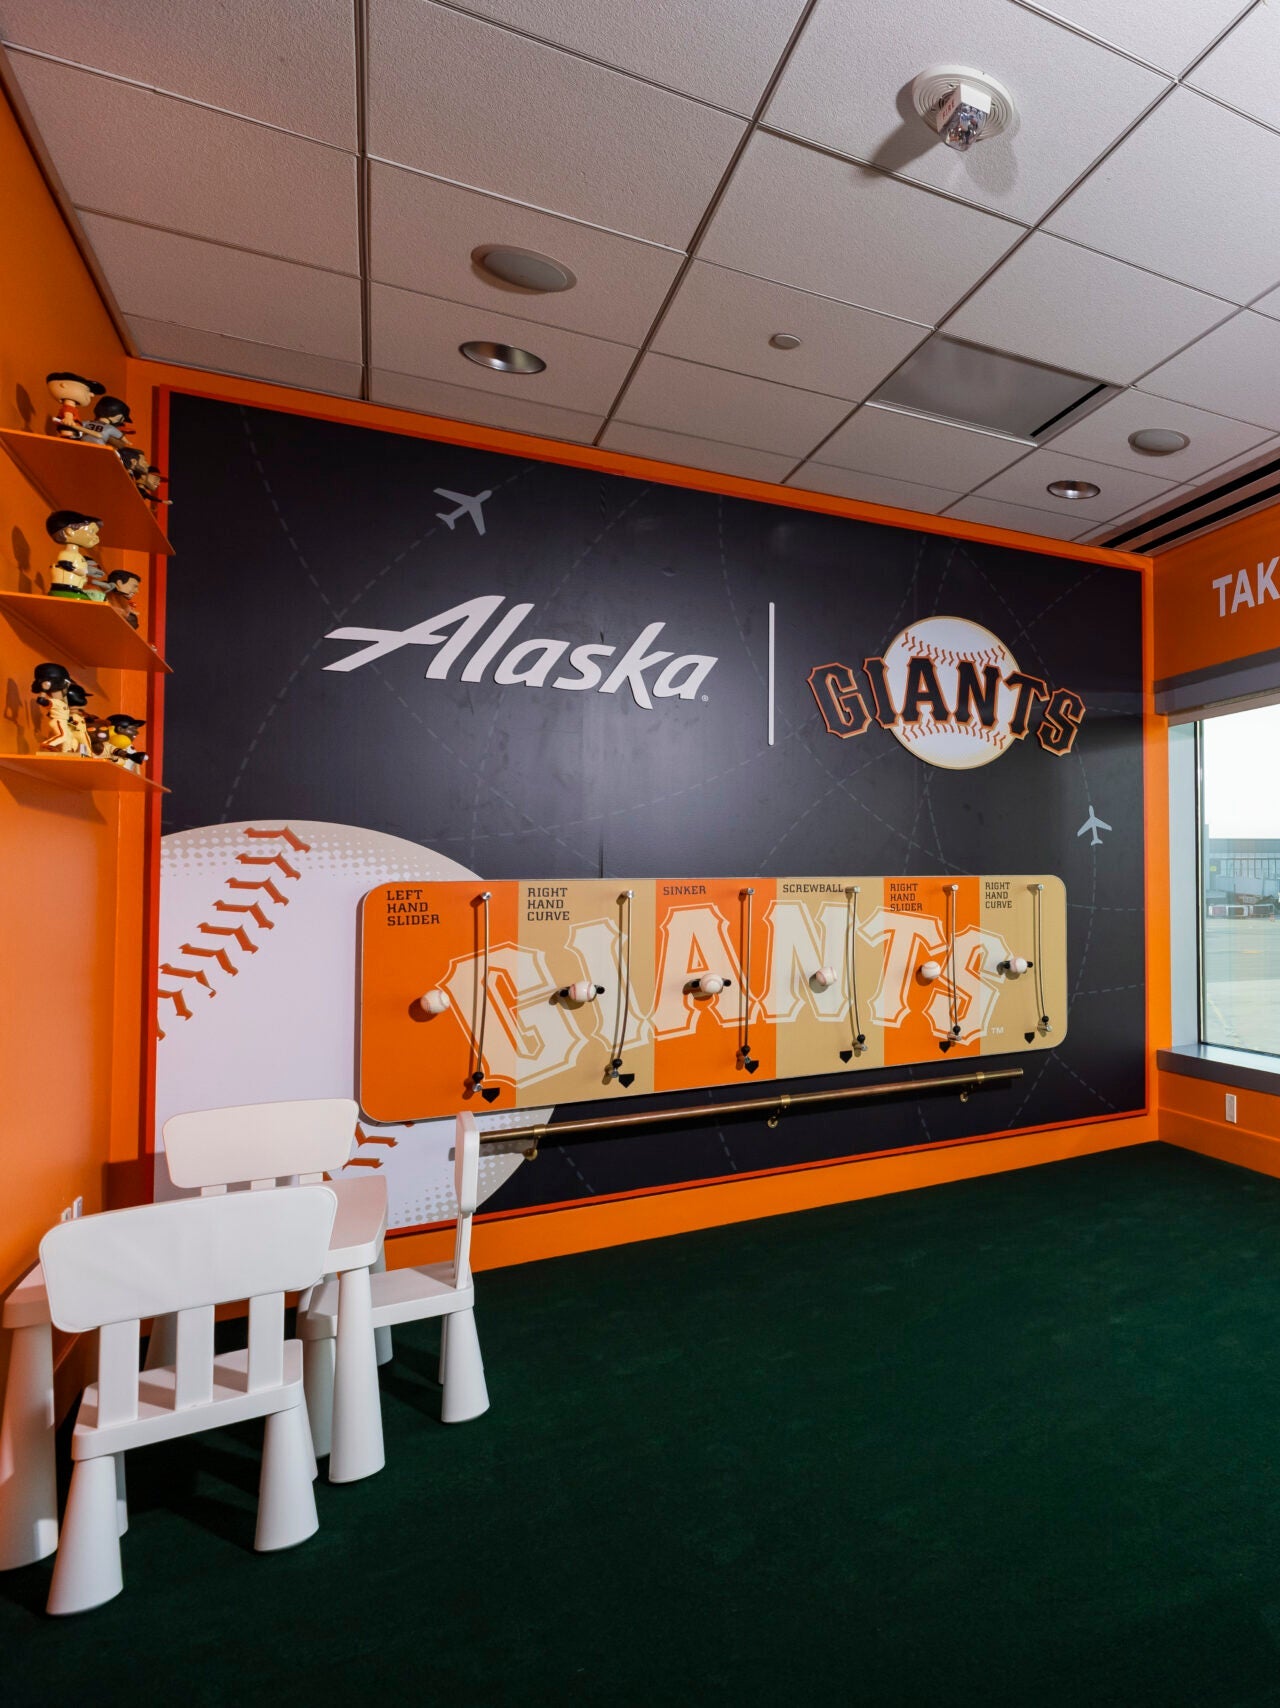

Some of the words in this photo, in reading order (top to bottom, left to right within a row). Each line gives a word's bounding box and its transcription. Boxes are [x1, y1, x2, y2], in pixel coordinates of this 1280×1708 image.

[322, 596, 719, 710] Alaska
[806, 656, 1087, 758] GIANTS
[662, 885, 707, 896] SINKER
[782, 884, 844, 894] SCREWBALL
[890, 883, 918, 893] RIGHT
[985, 882, 1011, 891] RIGHT
[386, 889, 424, 901] LEFT
[527, 887, 568, 898] RIGHT
[890, 893, 916, 902] HAND
[985, 891, 1009, 900] HAND
[386, 901, 429, 913] HAND
[527, 899, 565, 910] HAND
[890, 902, 923, 912] SLIDER
[985, 900, 1013, 909] CURVE
[387, 914, 440, 927] SLIDER
[527, 910, 570, 922] CURVE
[435, 900, 1014, 1088] GIANTS
